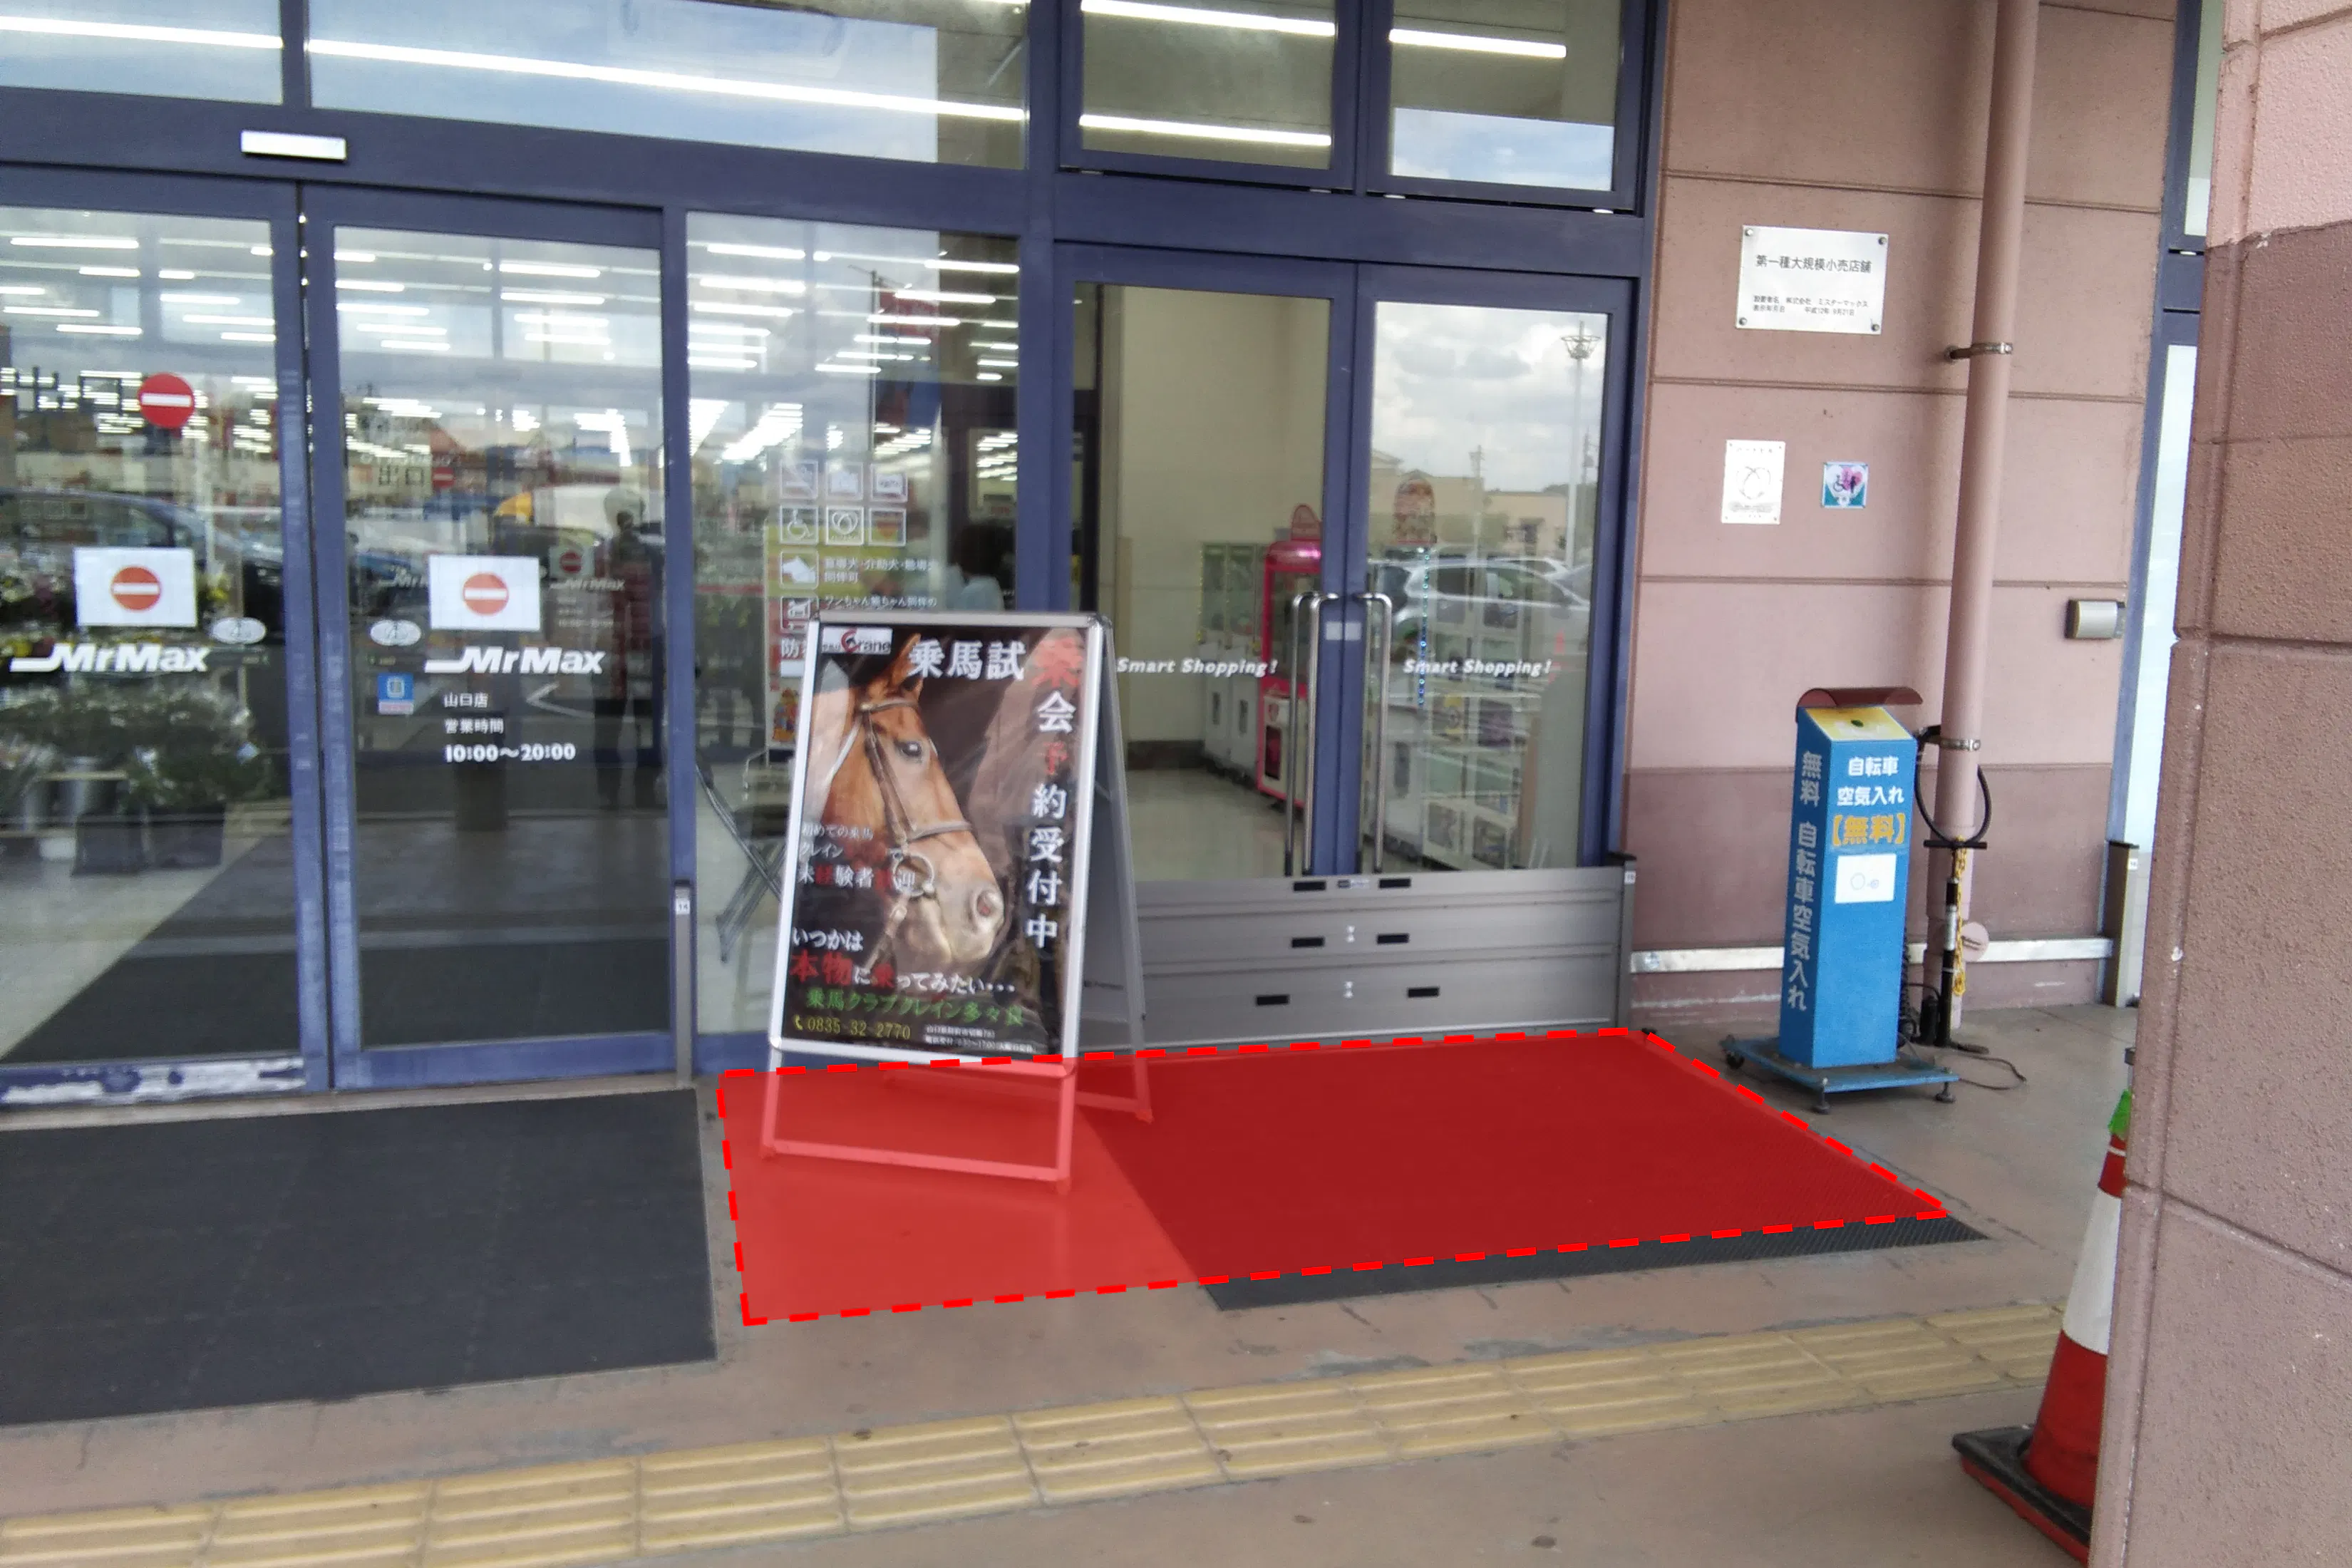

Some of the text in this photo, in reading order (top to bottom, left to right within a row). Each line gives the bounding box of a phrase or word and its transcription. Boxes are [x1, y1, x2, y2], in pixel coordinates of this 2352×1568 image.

[1755, 254, 1872, 274] 第一種大規模小売店舗
[9, 642, 212, 673] MrMax
[424, 646, 606, 674] MrMax
[907, 639, 1027, 681] 乗馬試
[1116, 656, 1176, 674] Smart
[1402, 658, 1458, 674] Smart
[444, 718, 504, 734] 営業時間
[1847, 756, 1899, 777] 自転車
[1837, 786, 1905, 807] 空気入れ
[793, 927, 864, 951] いつかは
